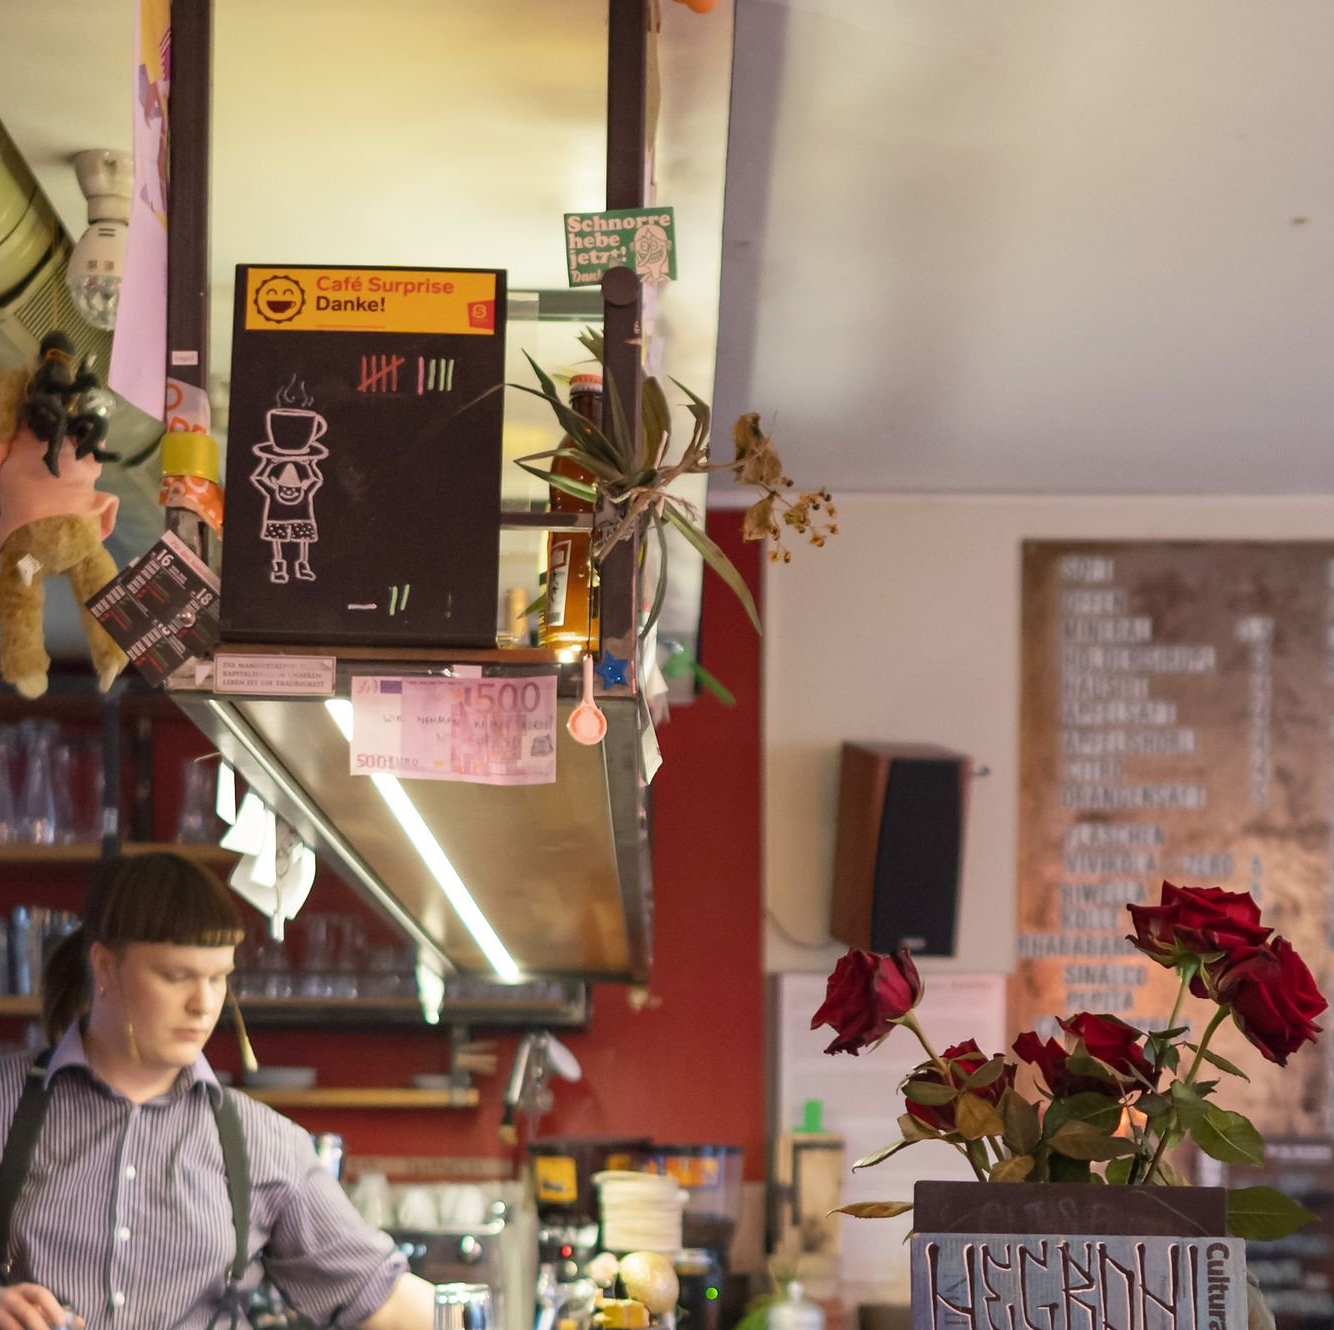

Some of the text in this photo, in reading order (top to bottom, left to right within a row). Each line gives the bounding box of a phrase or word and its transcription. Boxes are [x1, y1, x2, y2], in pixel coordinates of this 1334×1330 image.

[567, 215, 671, 233] Schnorre
[569, 232, 620, 249] hebe
[316, 275, 455, 297] Café Surprise
[316, 296, 386, 313] Danke!
[156, 548, 175, 567] 16
[196, 587, 213, 606] 18
[475, 682, 542, 713] 500
[356, 754, 387, 769] 500
